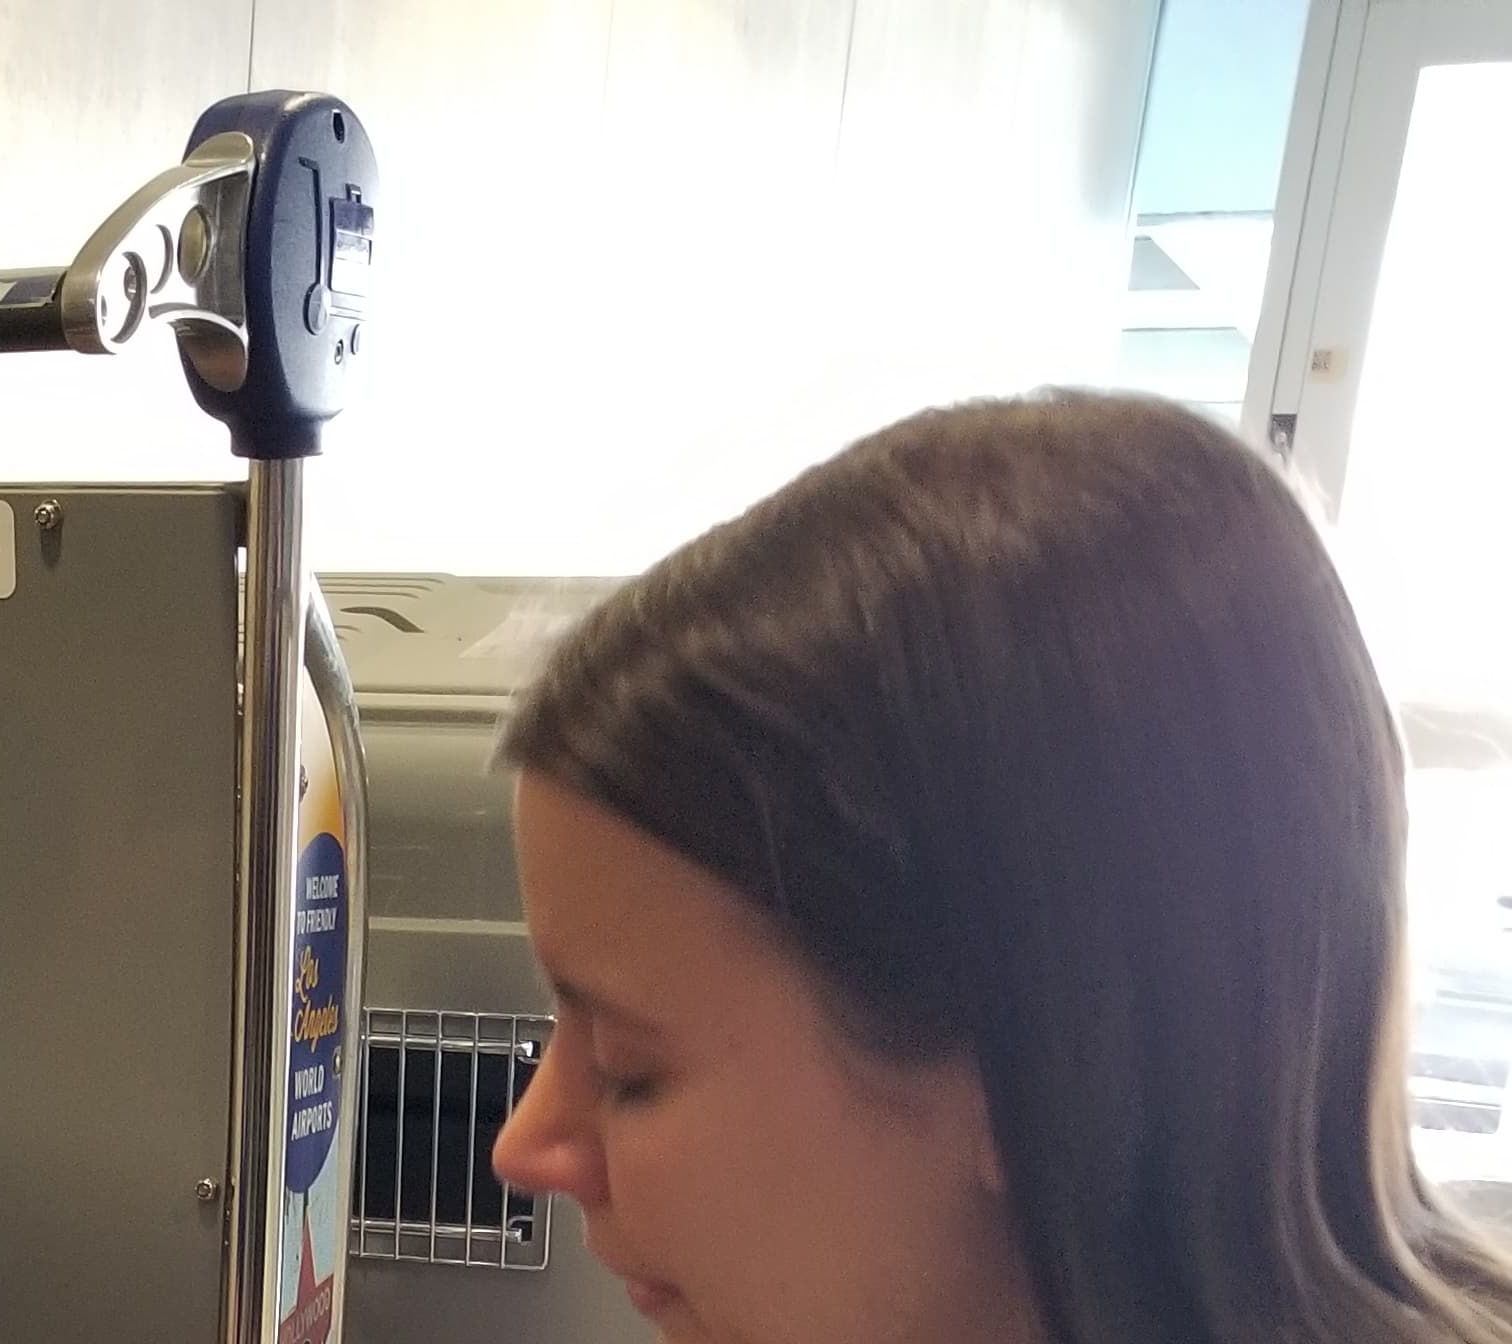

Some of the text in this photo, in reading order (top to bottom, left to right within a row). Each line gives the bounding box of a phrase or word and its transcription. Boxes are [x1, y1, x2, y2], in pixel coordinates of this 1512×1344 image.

[306, 874, 339, 900] WELCOME
[296, 907, 338, 935] TO FRIENDLY
[295, 945, 320, 1001] Los
[293, 994, 339, 1053] Angeles
[294, 1064, 325, 1100] WORLD
[291, 1101, 333, 1141] AIRPORTS
